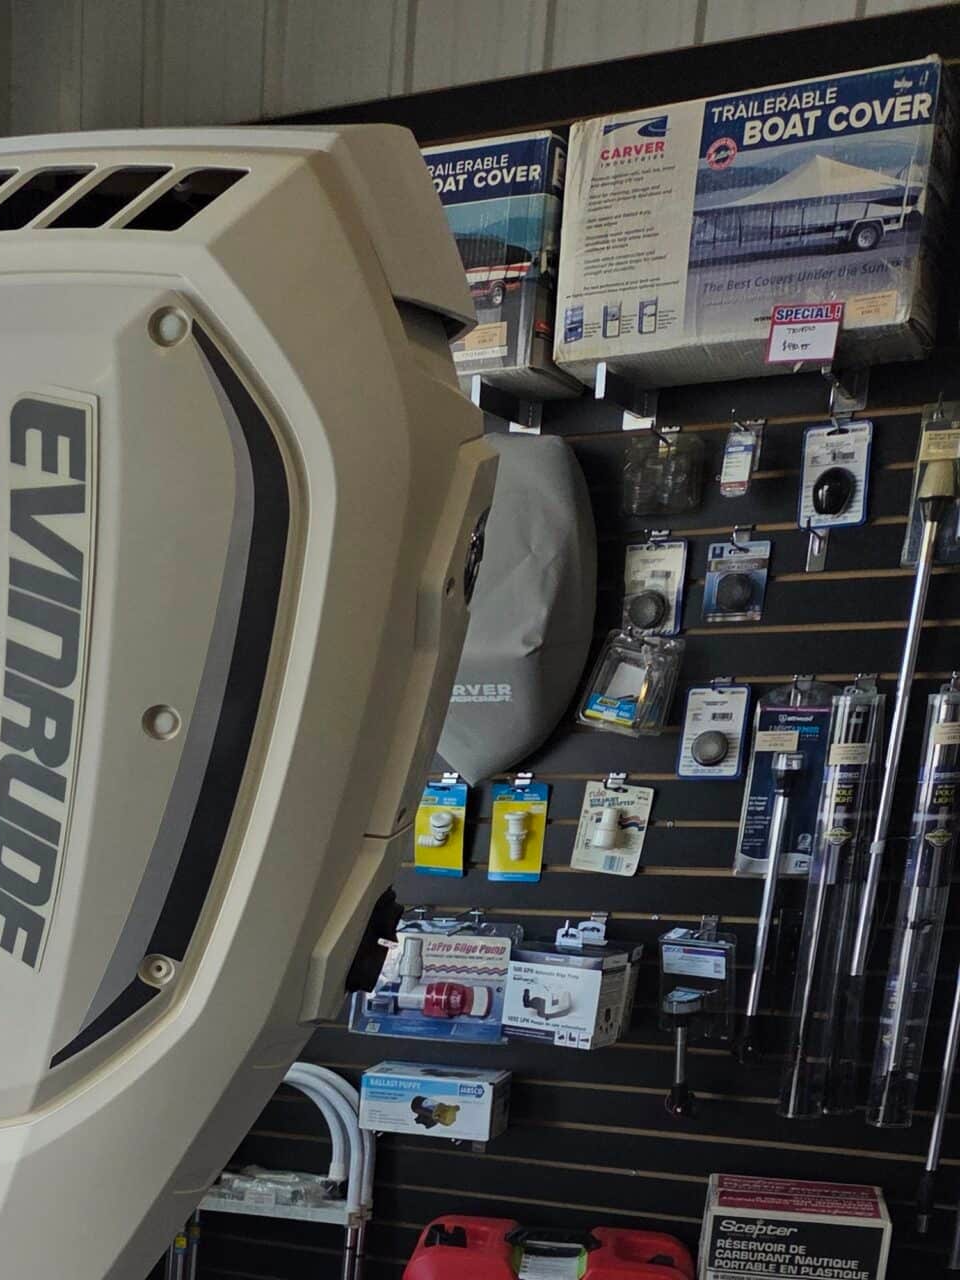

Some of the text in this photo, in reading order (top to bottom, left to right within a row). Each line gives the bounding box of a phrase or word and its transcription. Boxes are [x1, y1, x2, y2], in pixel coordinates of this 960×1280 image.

[711, 87, 838, 123] TRAILERABLE
[742, 92, 933, 146] BOAT COVER
[600, 141, 665, 161] CARVER
[426, 153, 510, 177] RAILERABLE
[432, 164, 542, 193] OAT COVER
[703, 282, 724, 294] The
[727, 278, 752, 291] Best
[754, 274, 794, 288] Covers
[797, 269, 835, 284] Under
[839, 265, 857, 279] the
[775, 306, 832, 321] SPECIAL
[452, 684, 513, 696] RVER
[719, 1219, 798, 1238] Scepter
[716, 1237, 808, 1255] RÉSERVOIR DE
[713, 1258, 870, 1280] PORTABLE EN PLASTIQUE
[715, 1248, 860, 1271] CARBURANT NAUTIQUE
